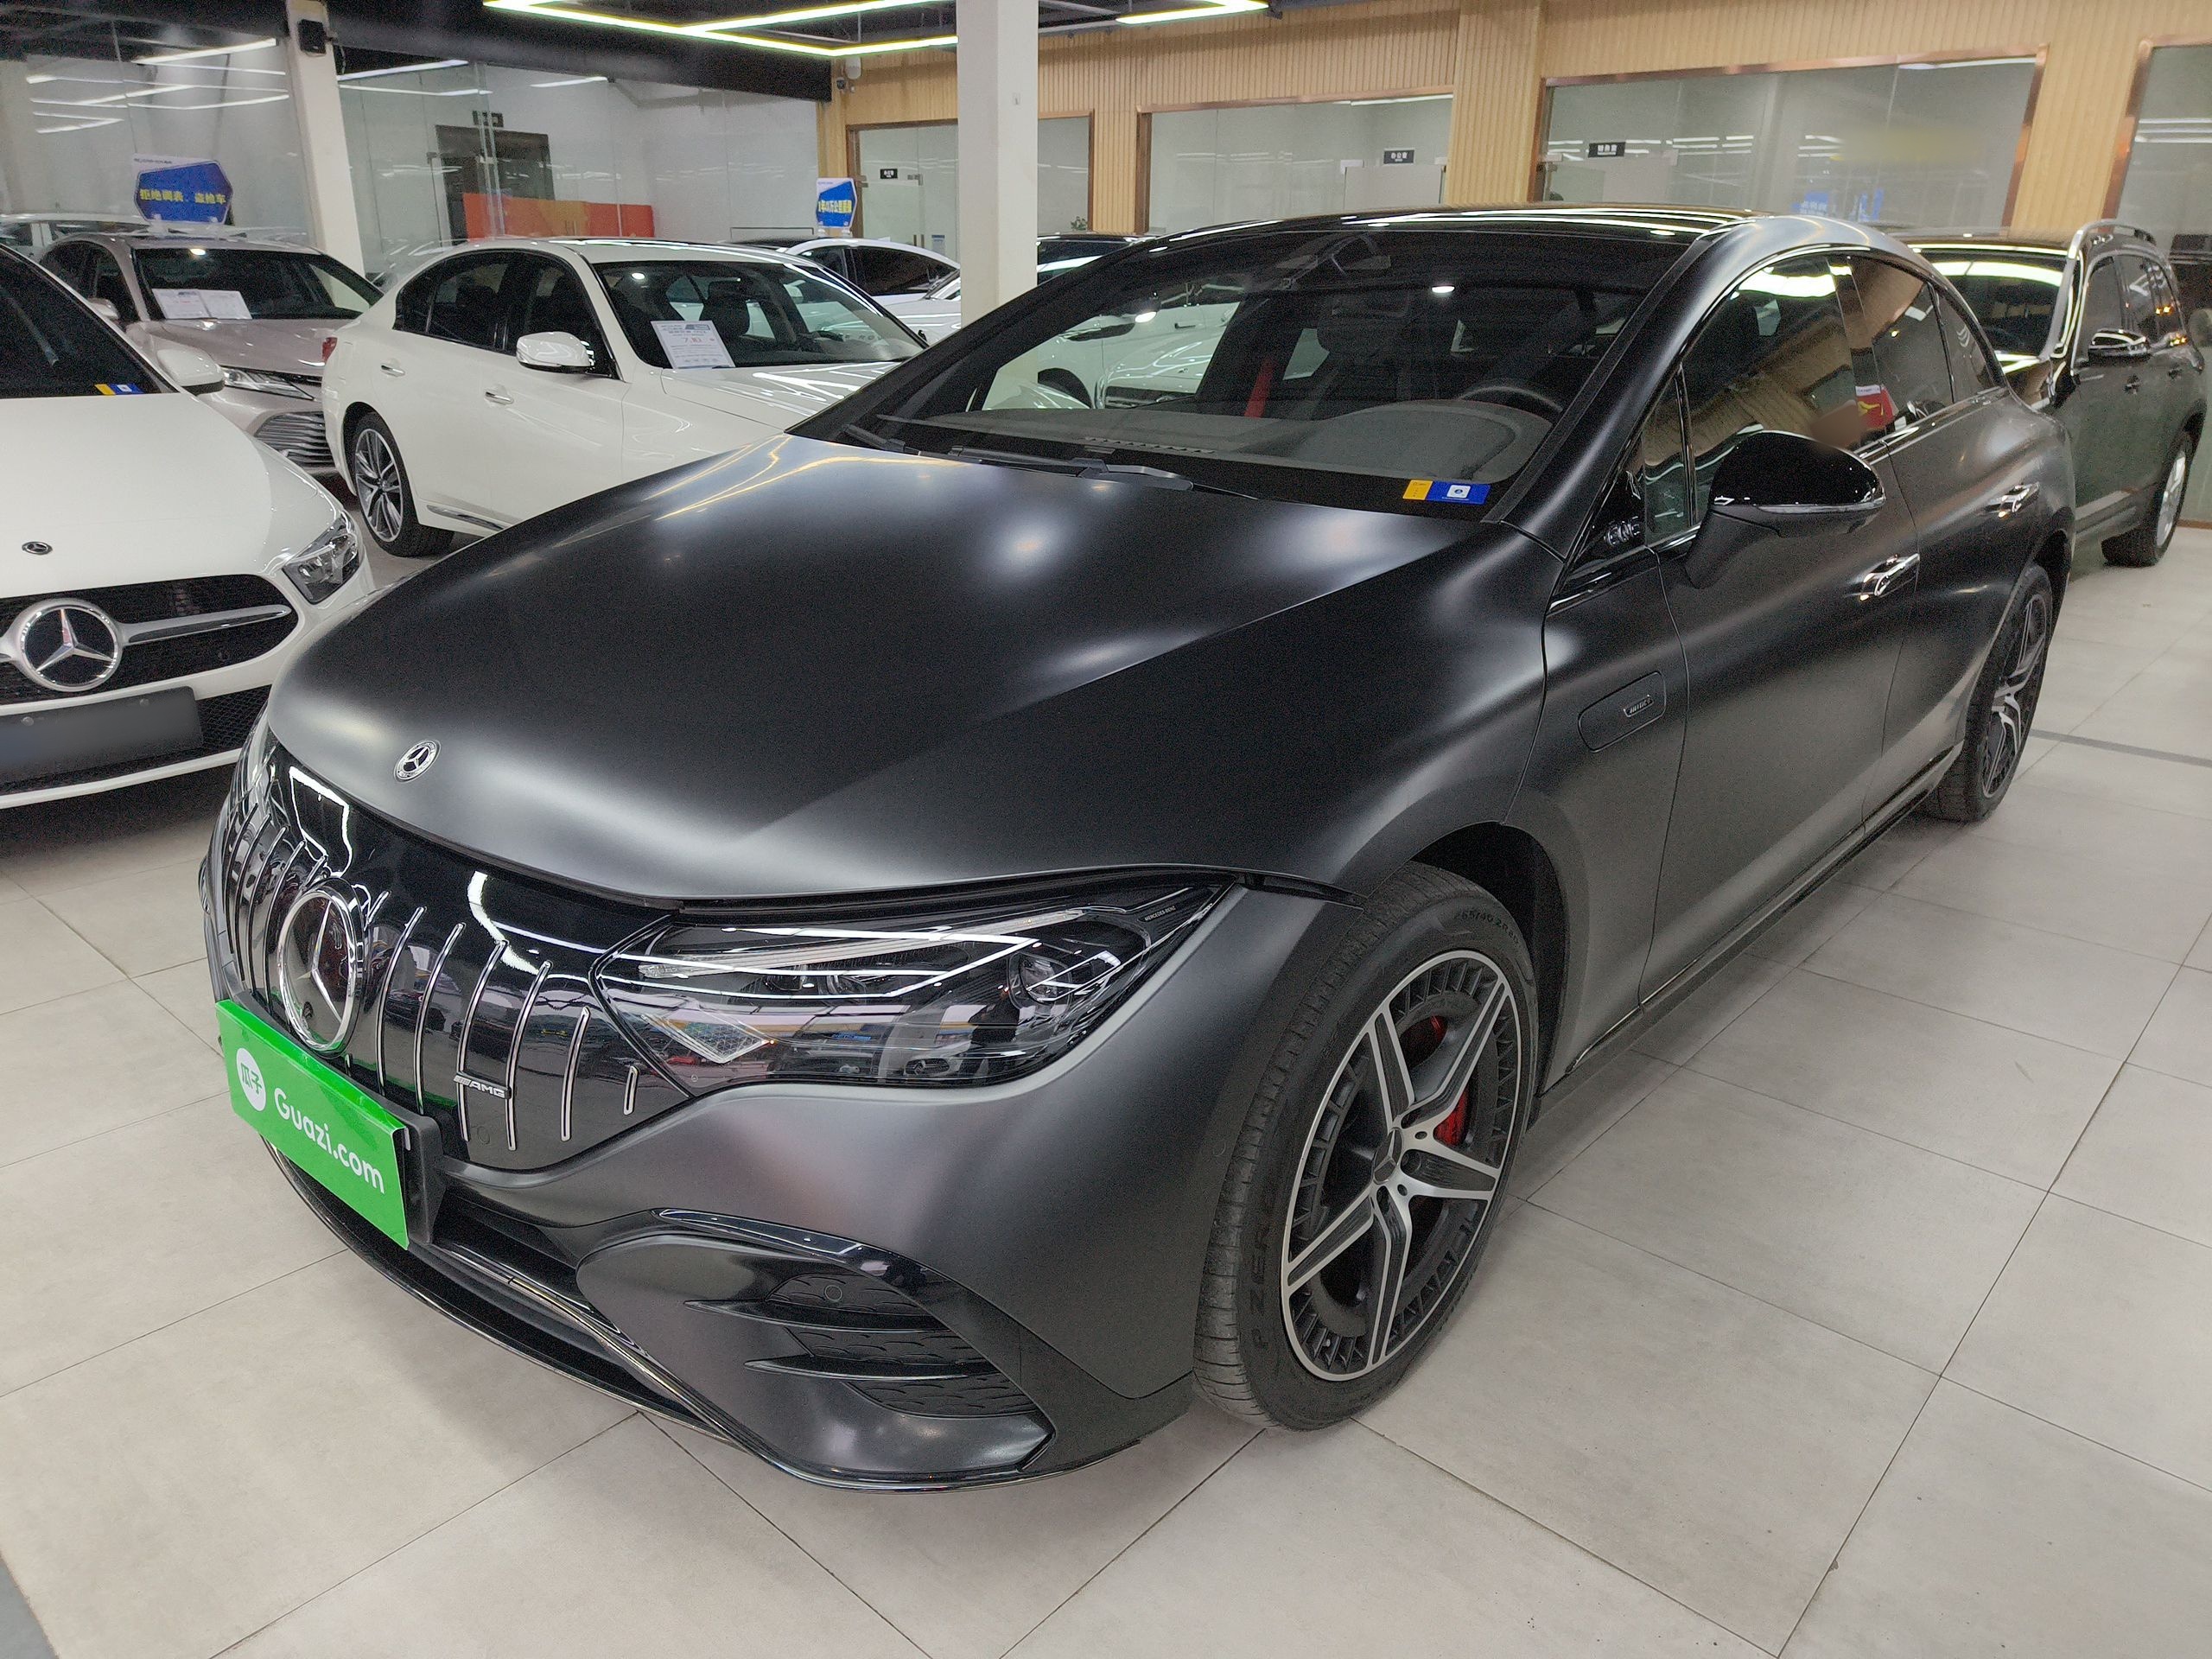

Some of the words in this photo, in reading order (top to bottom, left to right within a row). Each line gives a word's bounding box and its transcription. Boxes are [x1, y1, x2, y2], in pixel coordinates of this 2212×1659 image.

[241, 1062, 263, 1095] 瓜子
[468, 1080, 505, 1099] AMG
[274, 1087, 385, 1194] Guazi.com
